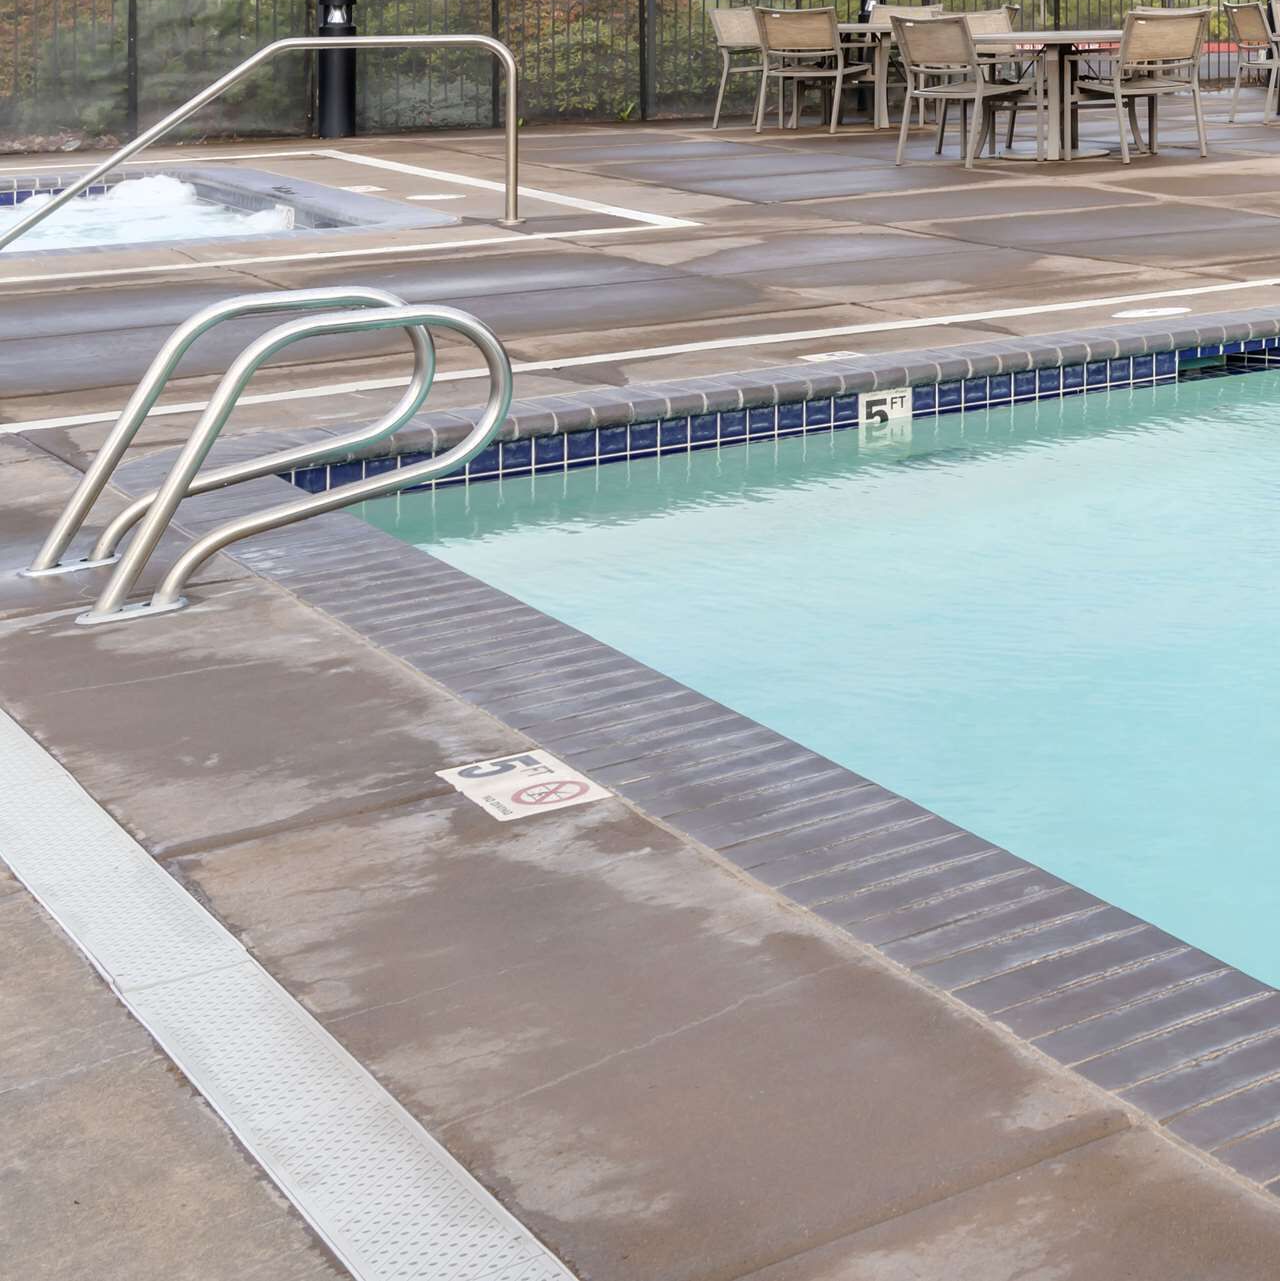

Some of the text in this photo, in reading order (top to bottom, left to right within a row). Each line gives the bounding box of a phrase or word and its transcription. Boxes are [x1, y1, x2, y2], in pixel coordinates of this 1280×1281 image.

[865, 395, 906, 424] 5 FT
[458, 755, 554, 778] 5 FT
